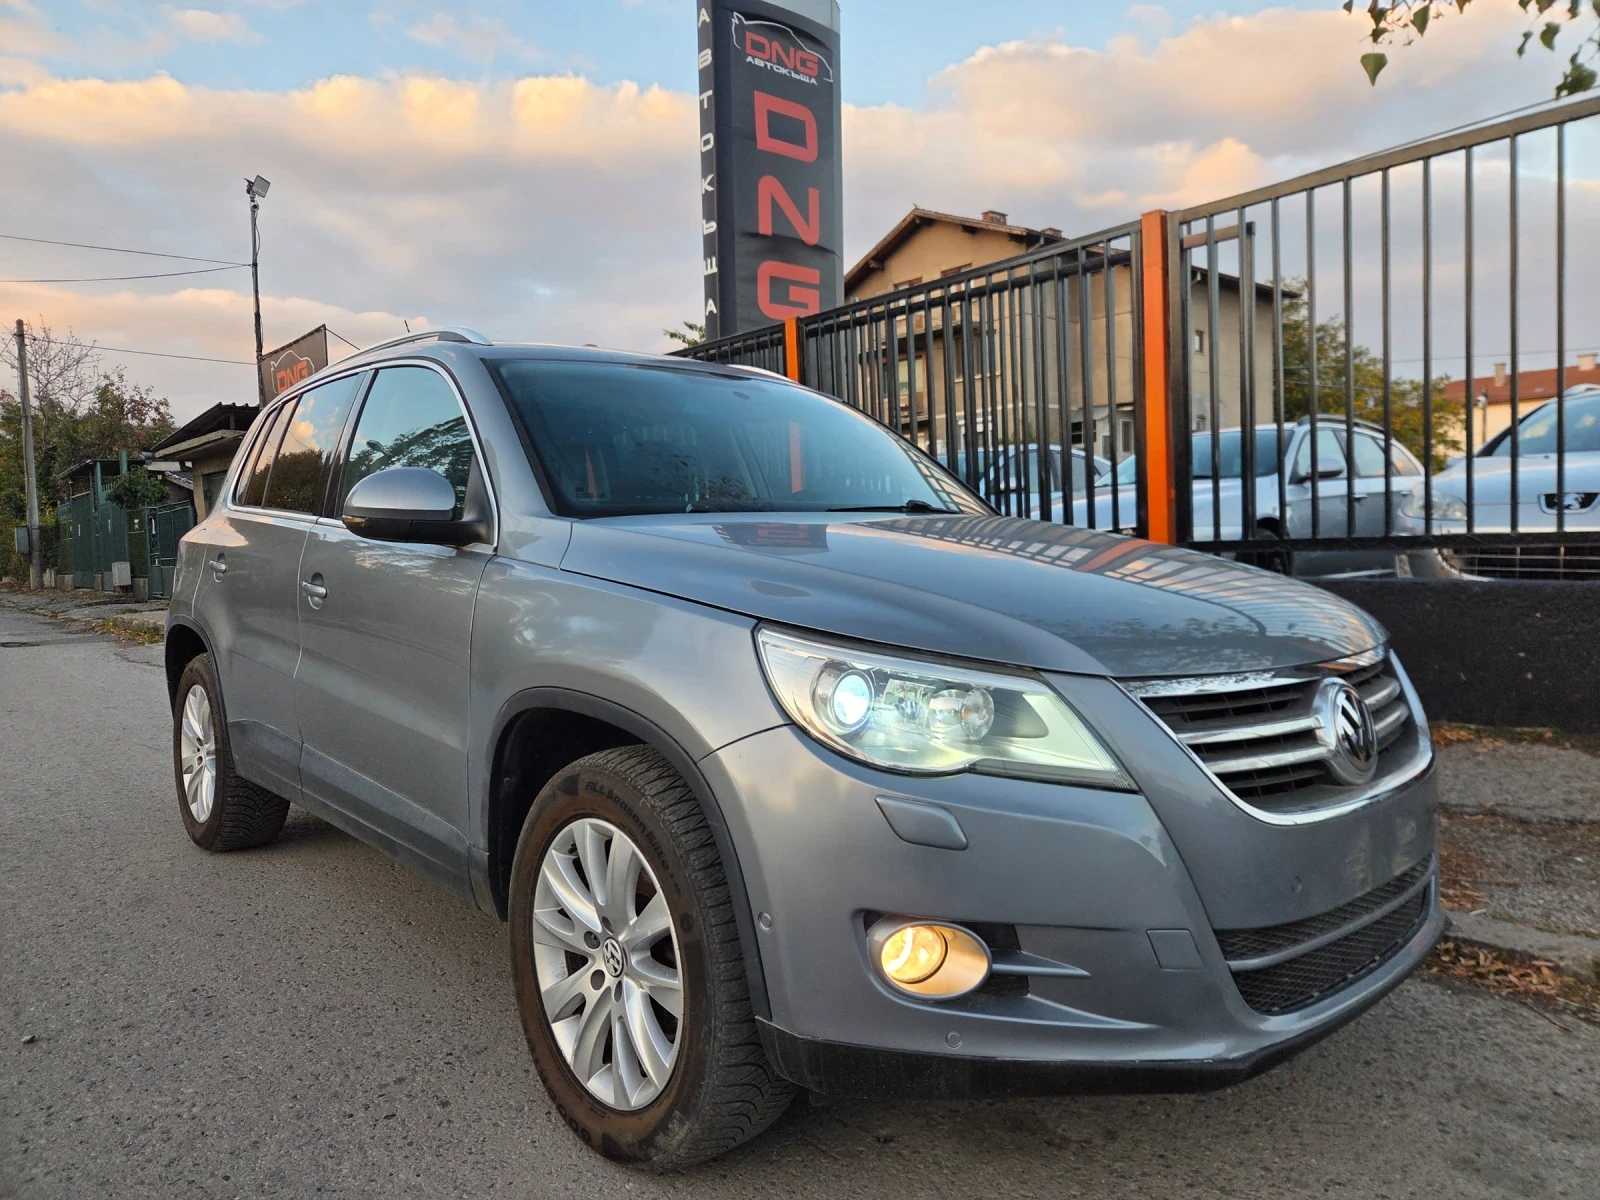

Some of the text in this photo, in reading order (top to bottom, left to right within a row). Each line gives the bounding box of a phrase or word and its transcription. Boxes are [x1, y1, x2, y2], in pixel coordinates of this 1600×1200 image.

[745, 31, 818, 77] DNG
[754, 89, 820, 321] DNG
[276, 359, 308, 395] DNG
